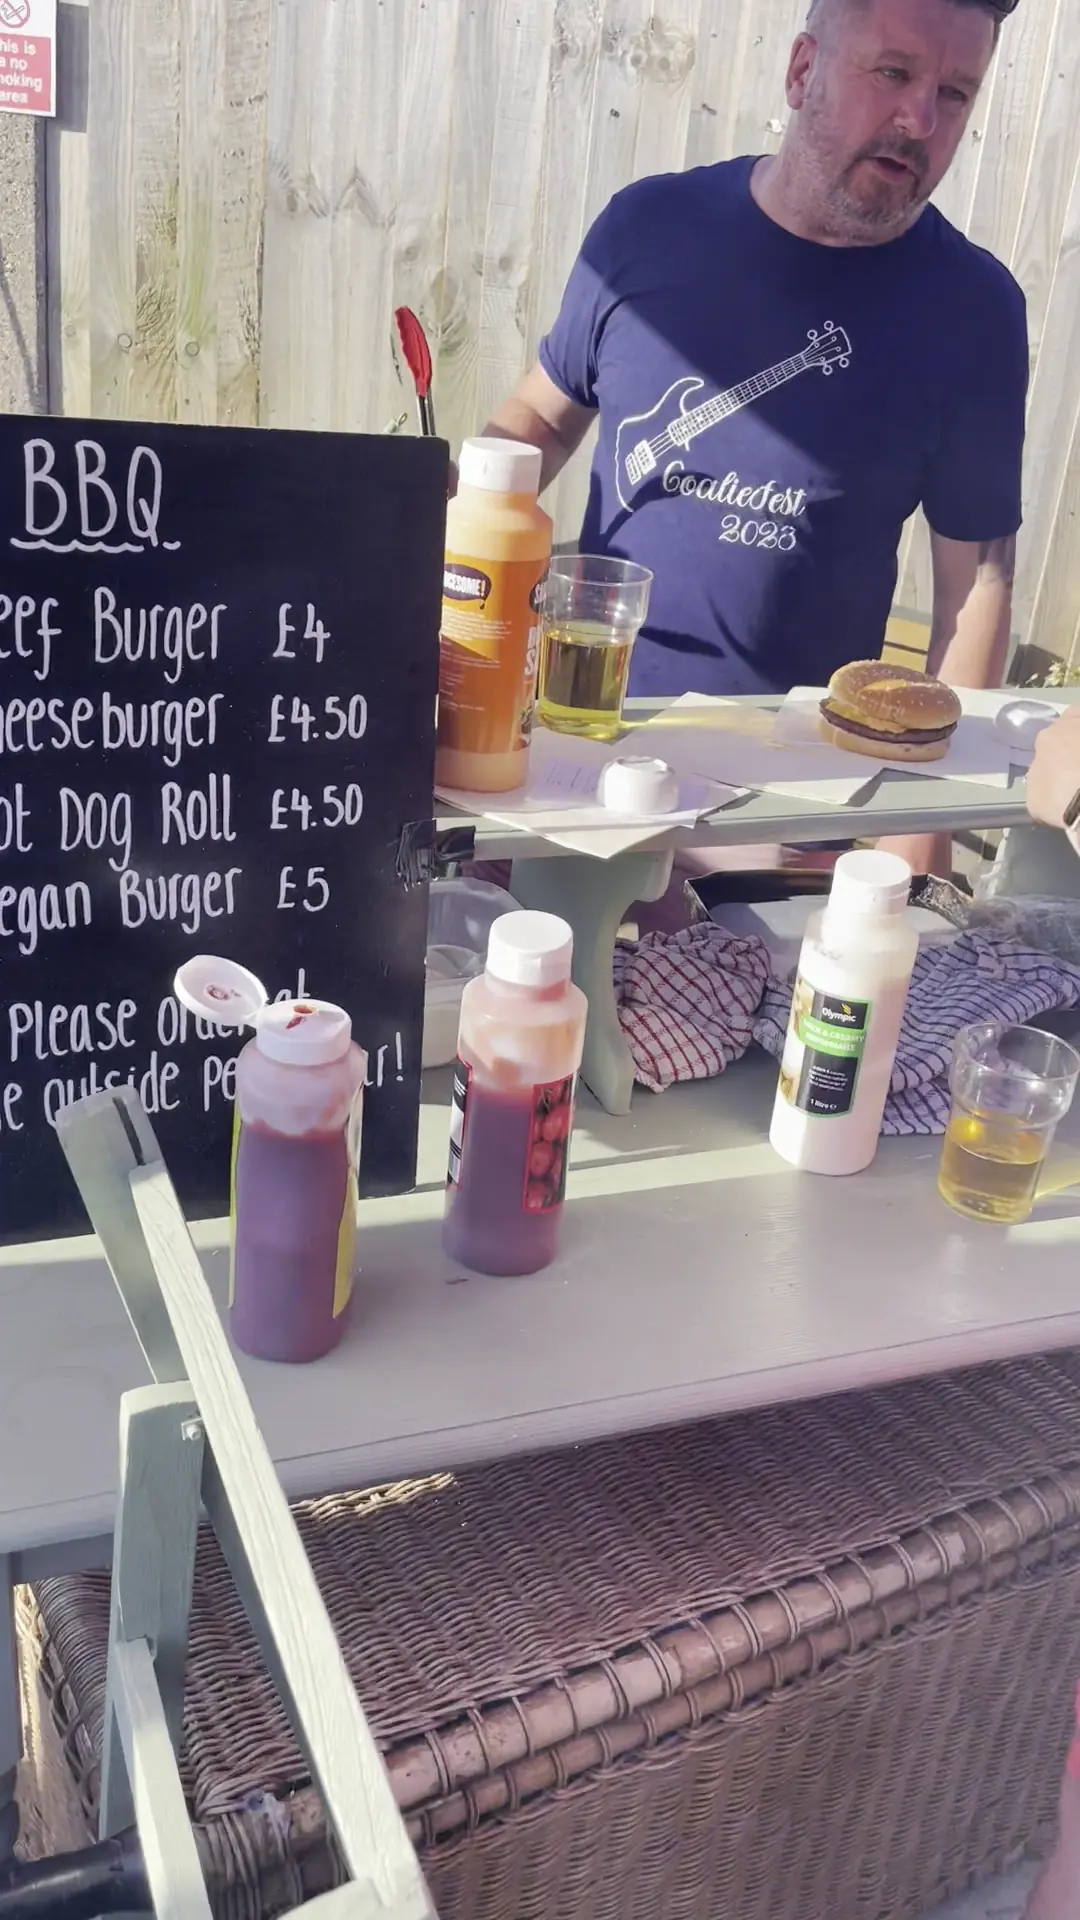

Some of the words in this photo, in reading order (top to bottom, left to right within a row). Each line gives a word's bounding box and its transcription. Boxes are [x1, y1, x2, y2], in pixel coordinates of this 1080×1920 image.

[10, 58, 28, 71] no
[24, 40, 36, 56] is
[24, 438, 162, 546] BBQ
[718, 514, 797, 551] 2023
[94, 586, 228, 684] Burger
[273, 602, 331, 663] £4
[267, 694, 368, 743] £4.50
[59, 787, 131, 872] Dog
[162, 773, 237, 846] Roll
[270, 783, 364, 831] £4.50
[119, 866, 242, 935] Burger
[277, 866, 330, 913] £5
[821, 1007, 857, 1022] Olympic
[0, 1083, 24, 1131] e
